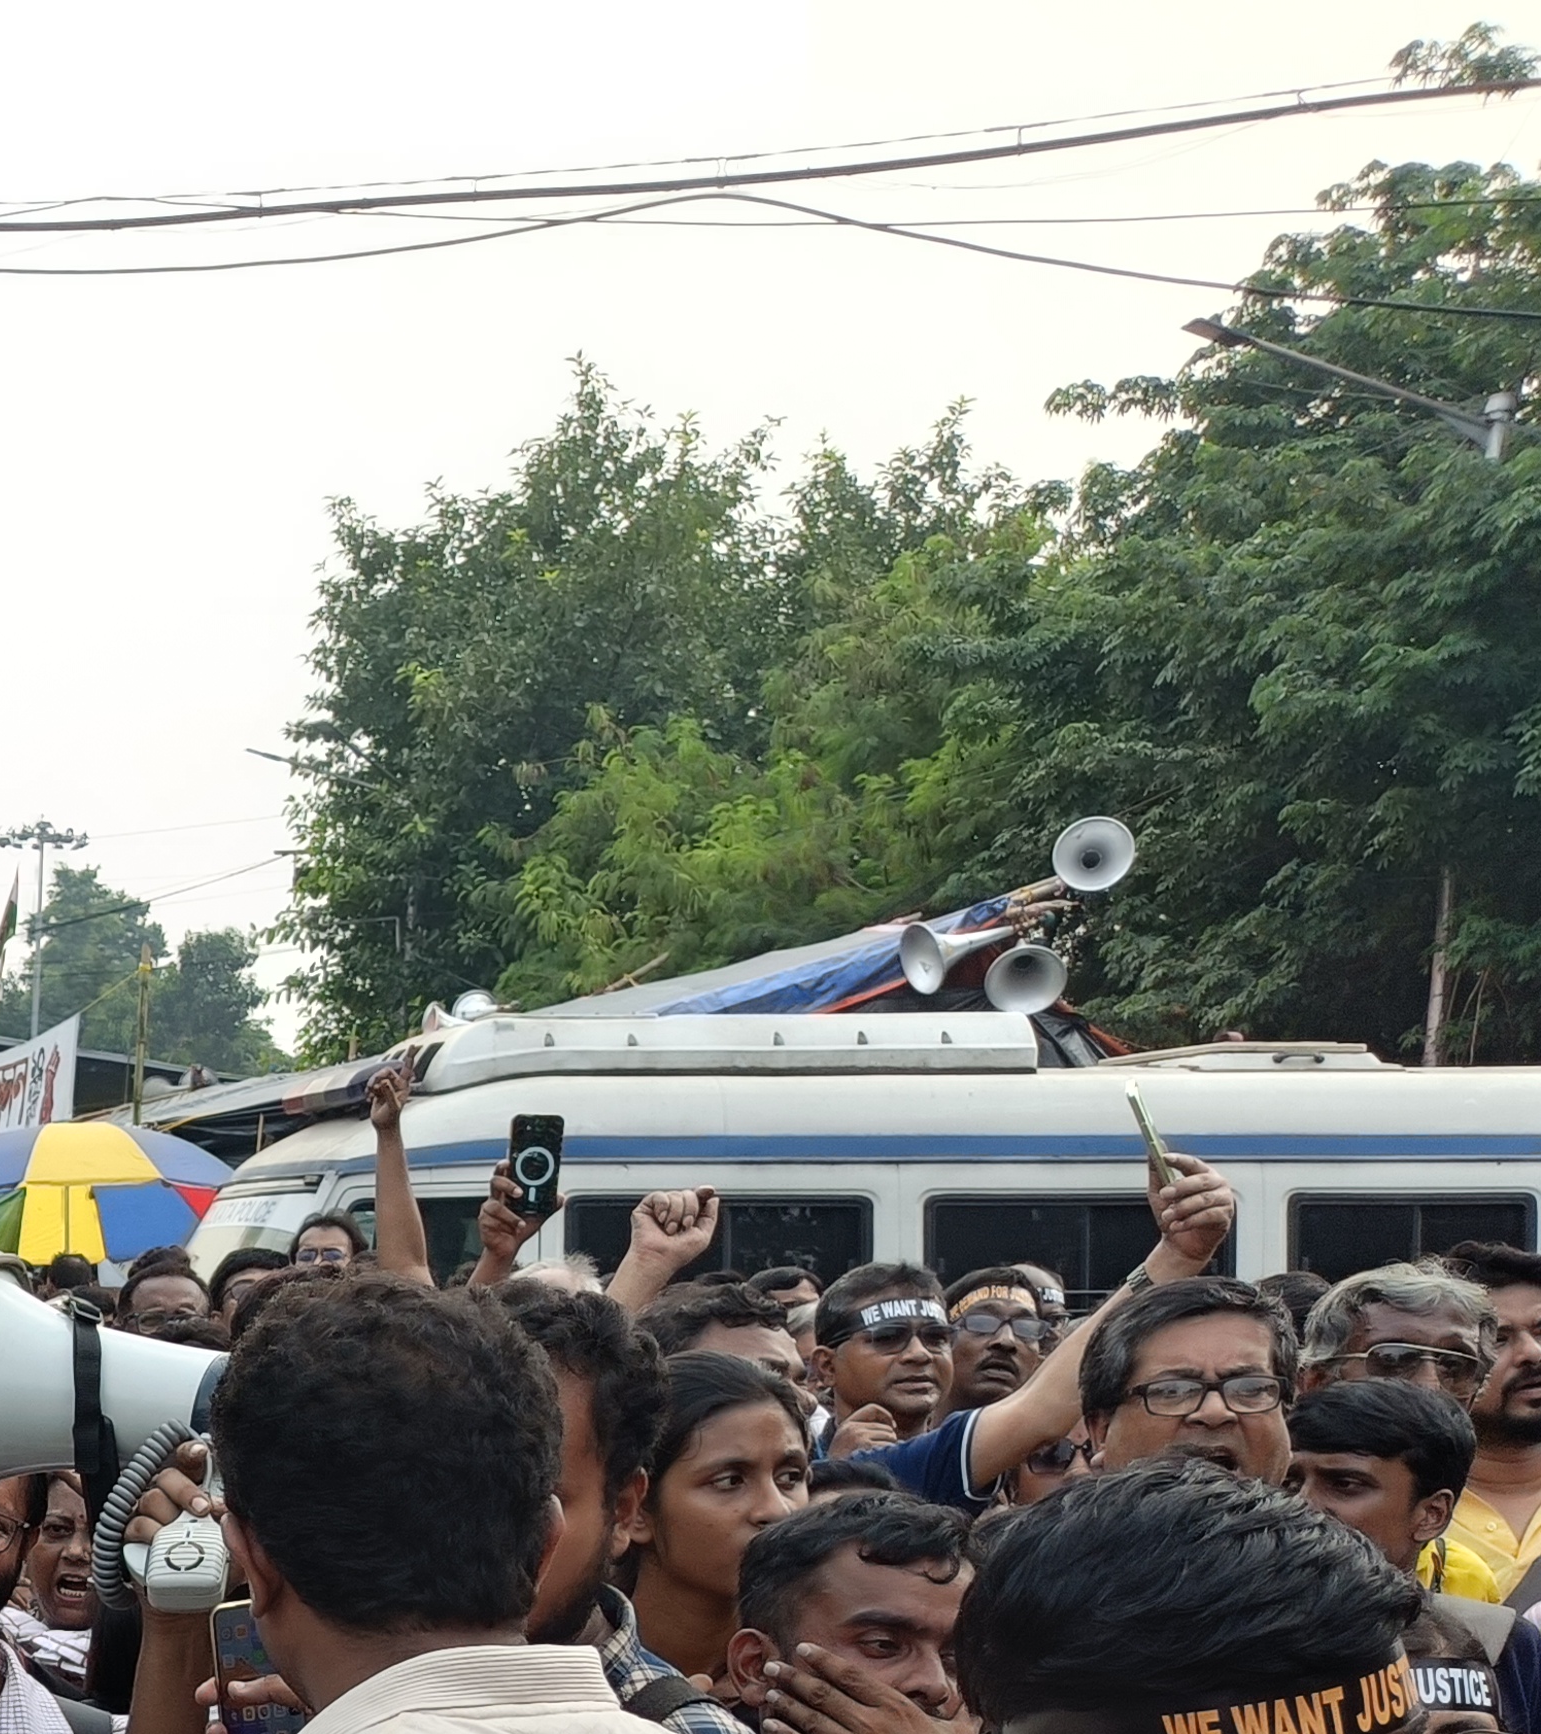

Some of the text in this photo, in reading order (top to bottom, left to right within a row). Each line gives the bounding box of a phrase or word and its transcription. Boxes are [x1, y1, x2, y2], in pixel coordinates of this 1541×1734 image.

[991, 1285, 1009, 1299] FOR
[861, 1303, 880, 1325] WE
[882, 1299, 917, 1320] WANT
